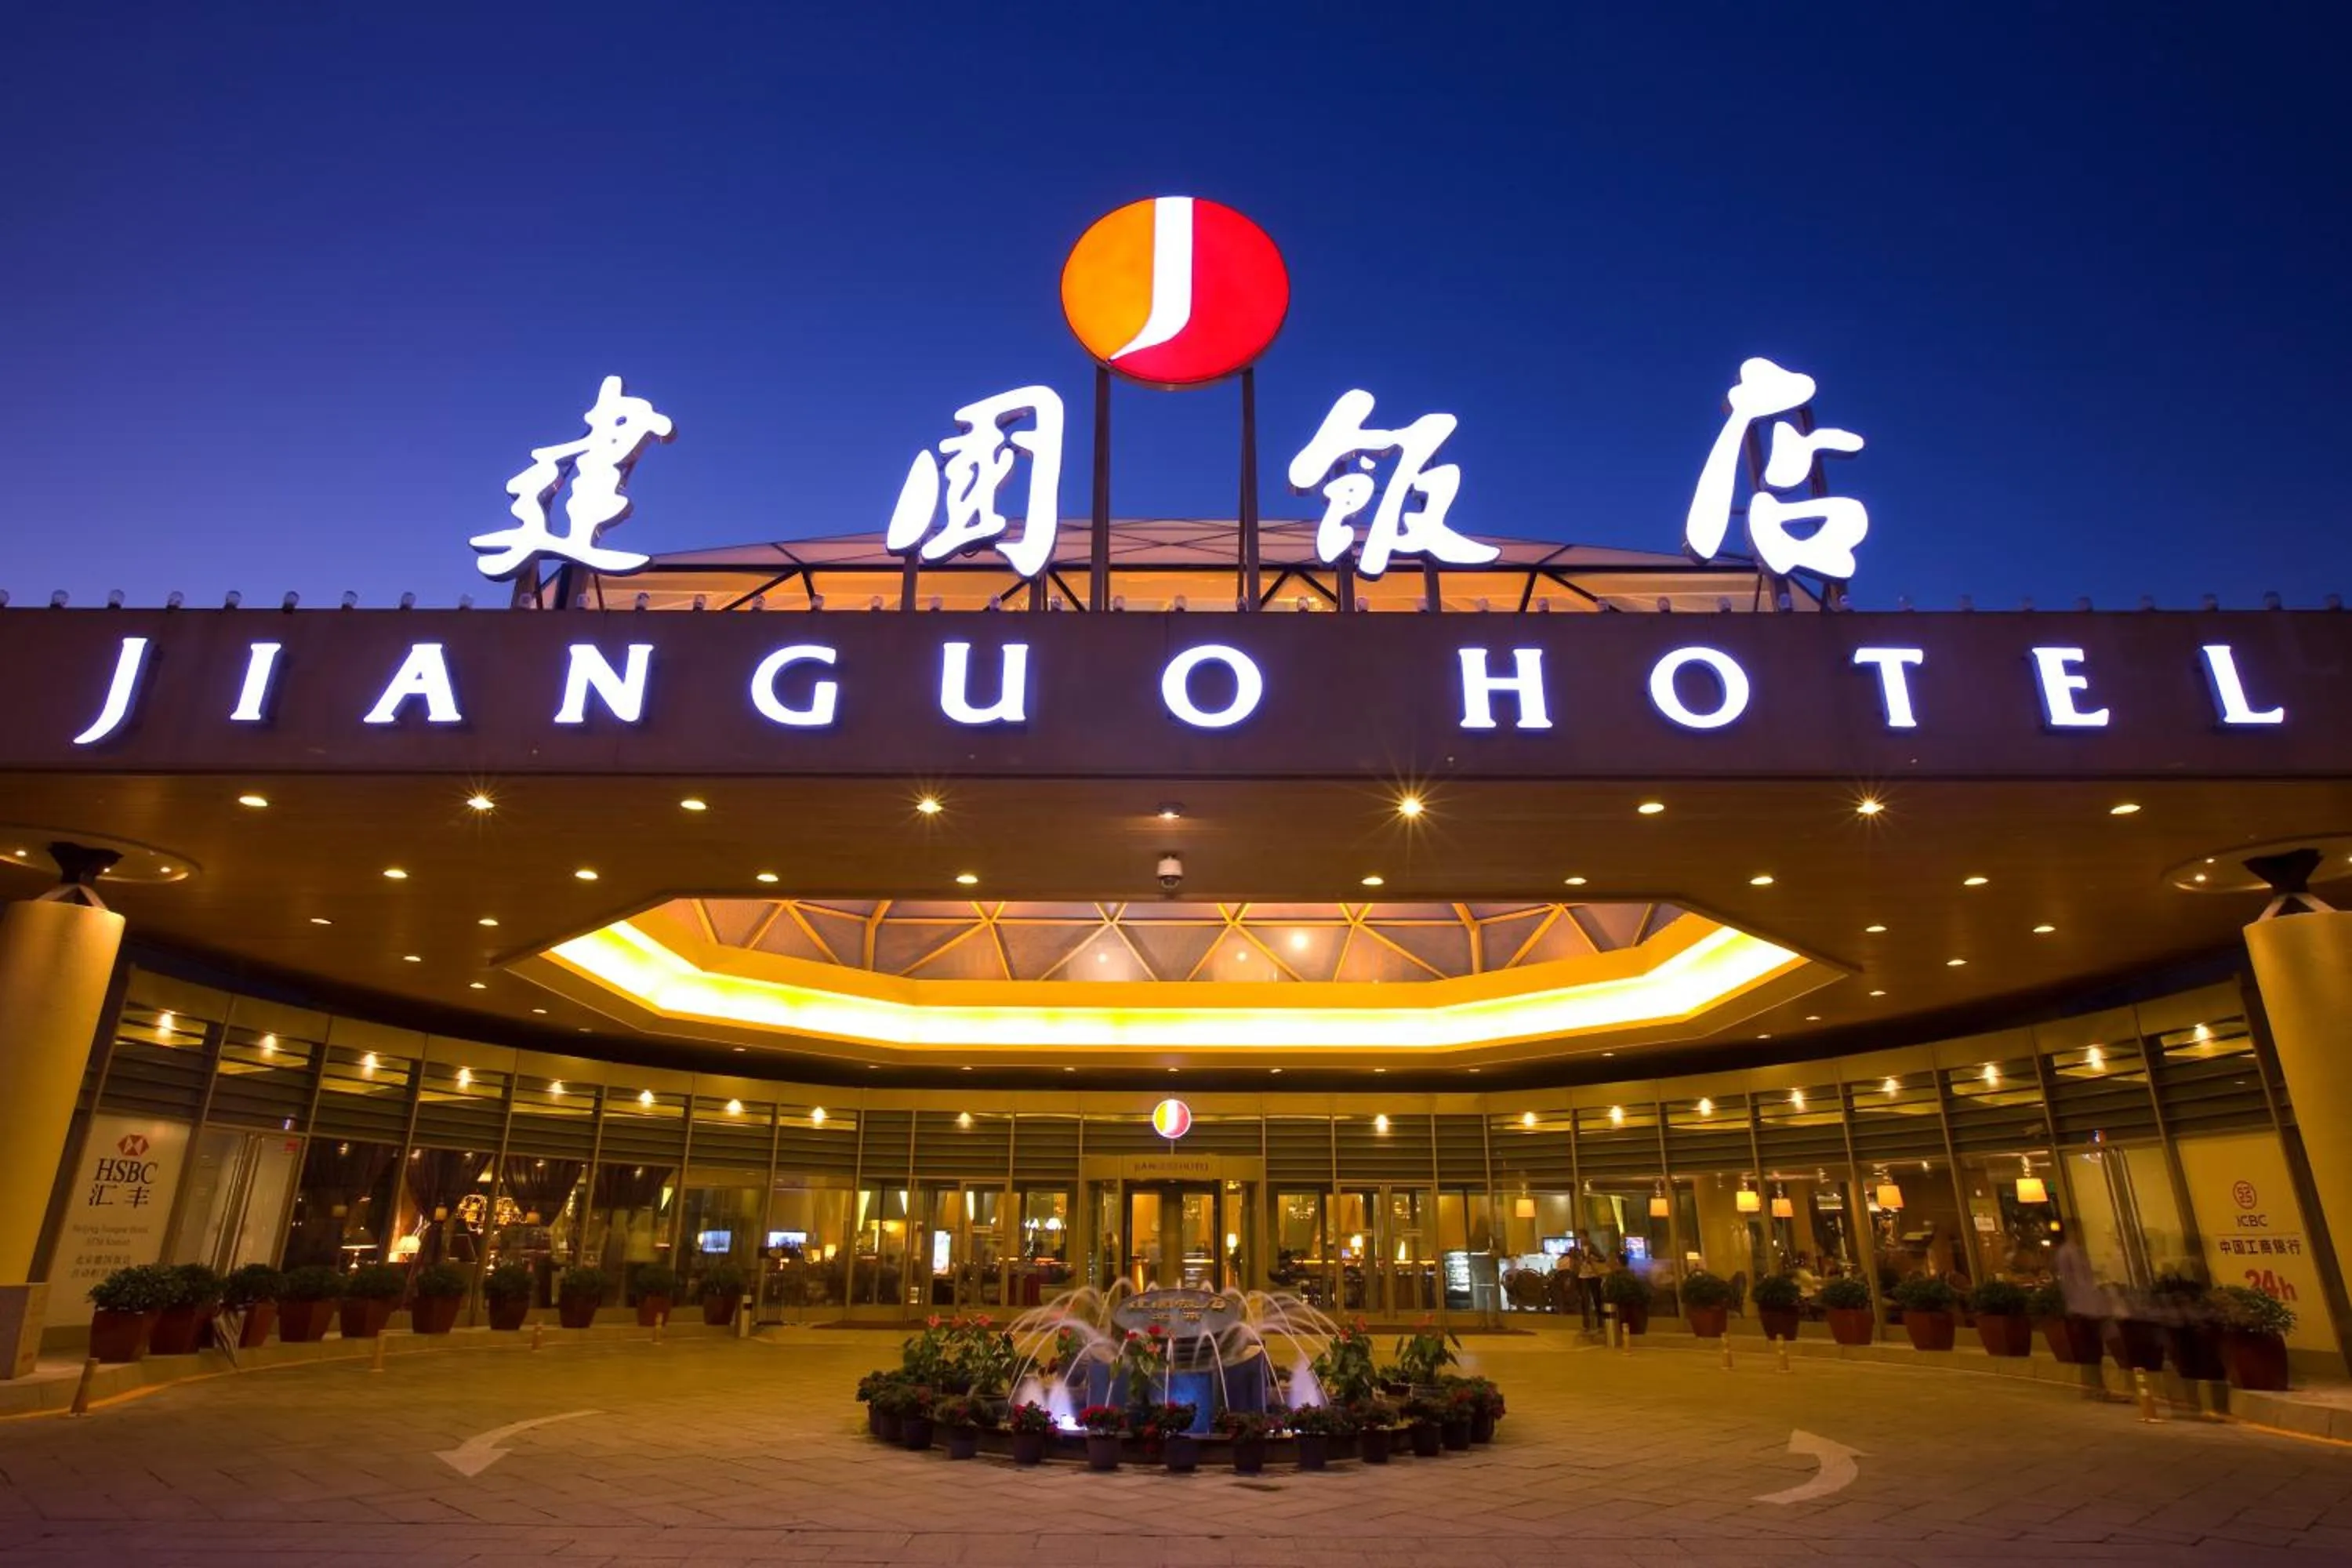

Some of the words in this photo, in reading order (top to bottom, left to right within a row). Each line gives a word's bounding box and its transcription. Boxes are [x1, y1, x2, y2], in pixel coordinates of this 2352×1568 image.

[73, 637, 1263, 744] JIANGUO
[1458, 644, 2285, 728] HOTEL
[94, 1158, 158, 1185] HSBC
[89, 1184, 150, 1208] 汇丰
[2236, 1214, 2269, 1228] ICBC
